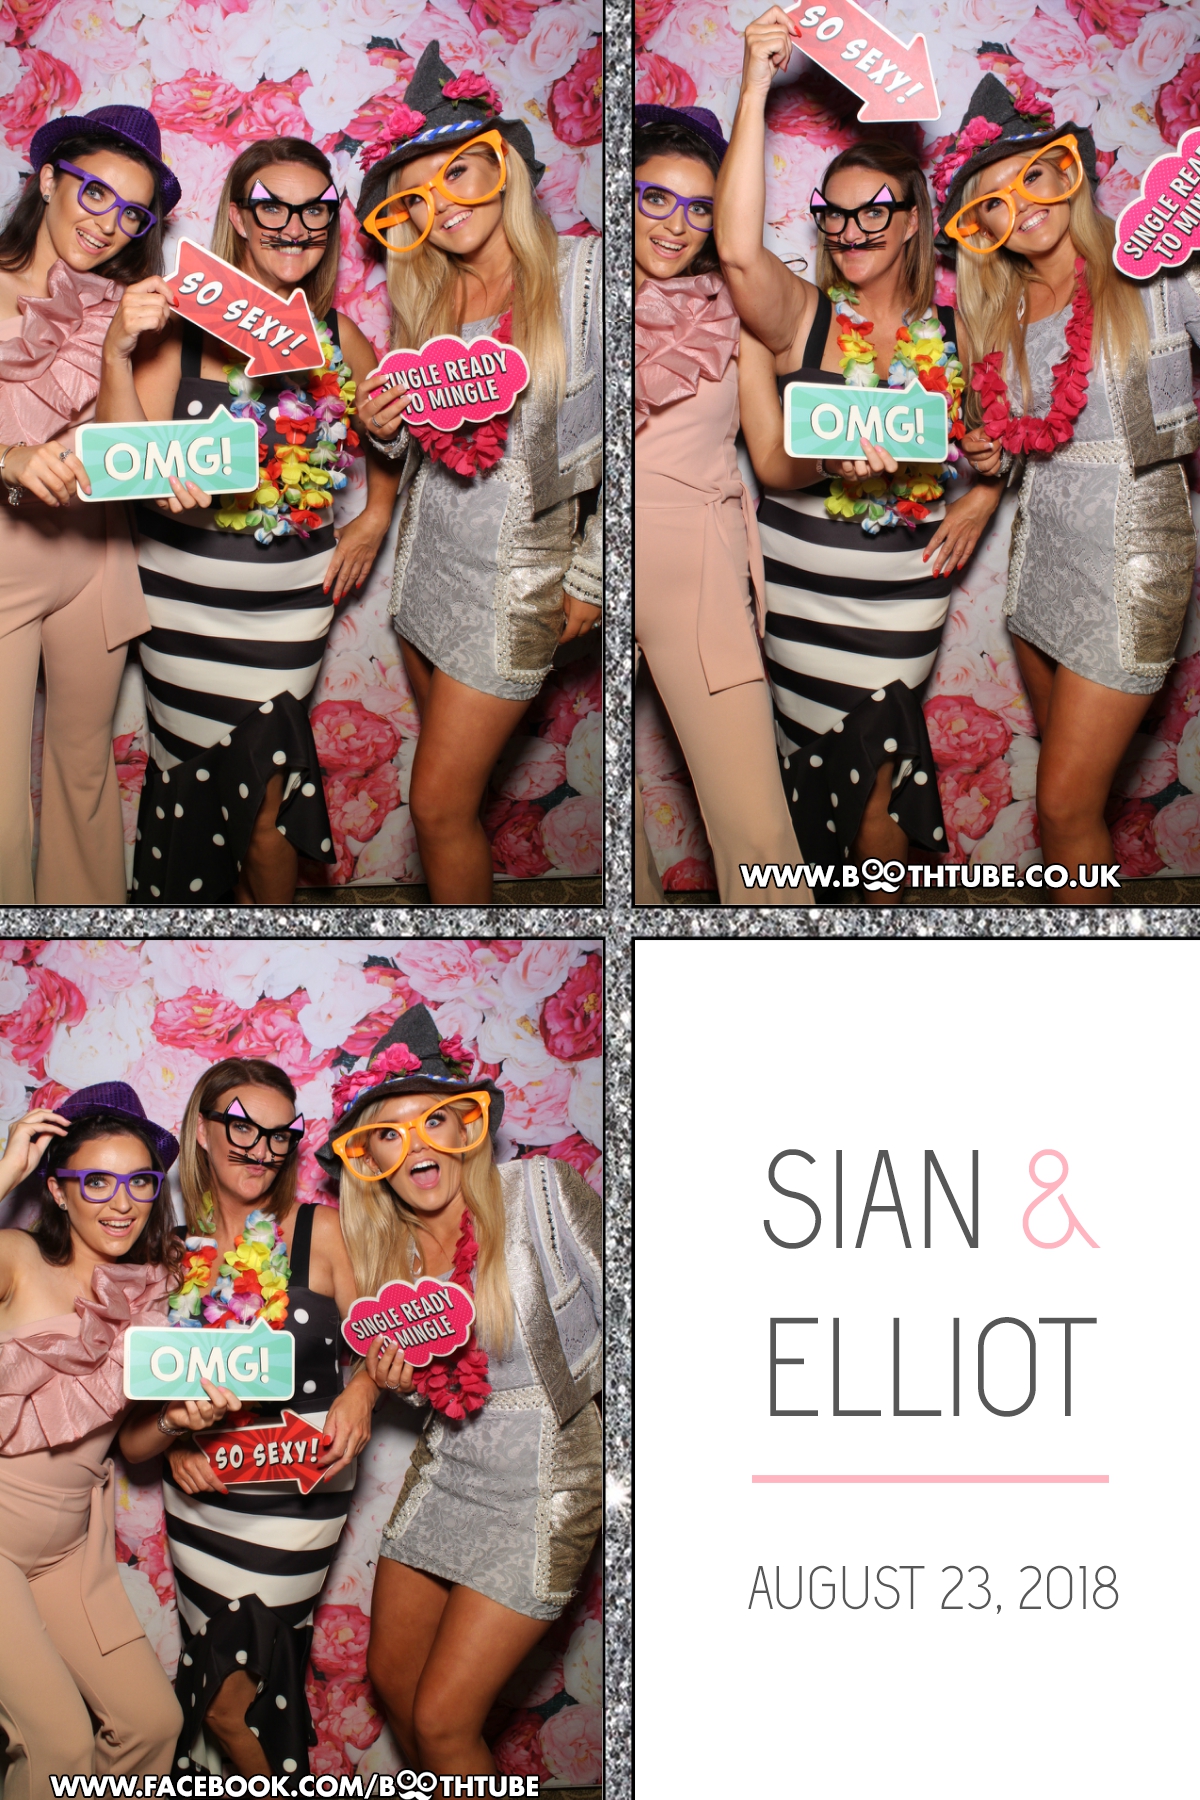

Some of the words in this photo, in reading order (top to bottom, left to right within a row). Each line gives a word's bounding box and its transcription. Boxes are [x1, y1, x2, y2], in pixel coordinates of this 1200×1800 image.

[799, 5, 844, 41] SO
[840, 38, 925, 104] SEXY!
[1122, 193, 1180, 261] SINGLE
[1169, 145, 1200, 199] REA
[1153, 232, 1183, 260] TO
[178, 271, 223, 306] SO
[222, 299, 308, 356] SEXY!
[444, 350, 507, 383] READY
[428, 379, 500, 411] MINGLE
[810, 402, 925, 445] OMG!
[104, 436, 232, 481] OMG!
[350, 1308, 403, 1341] SINGLE
[400, 1288, 454, 1323] READY
[394, 1315, 455, 1350] MINGLE
[150, 1345, 270, 1384] OMG!
[215, 1444, 244, 1470] SO
[252, 1437, 319, 1468] SEXY!
